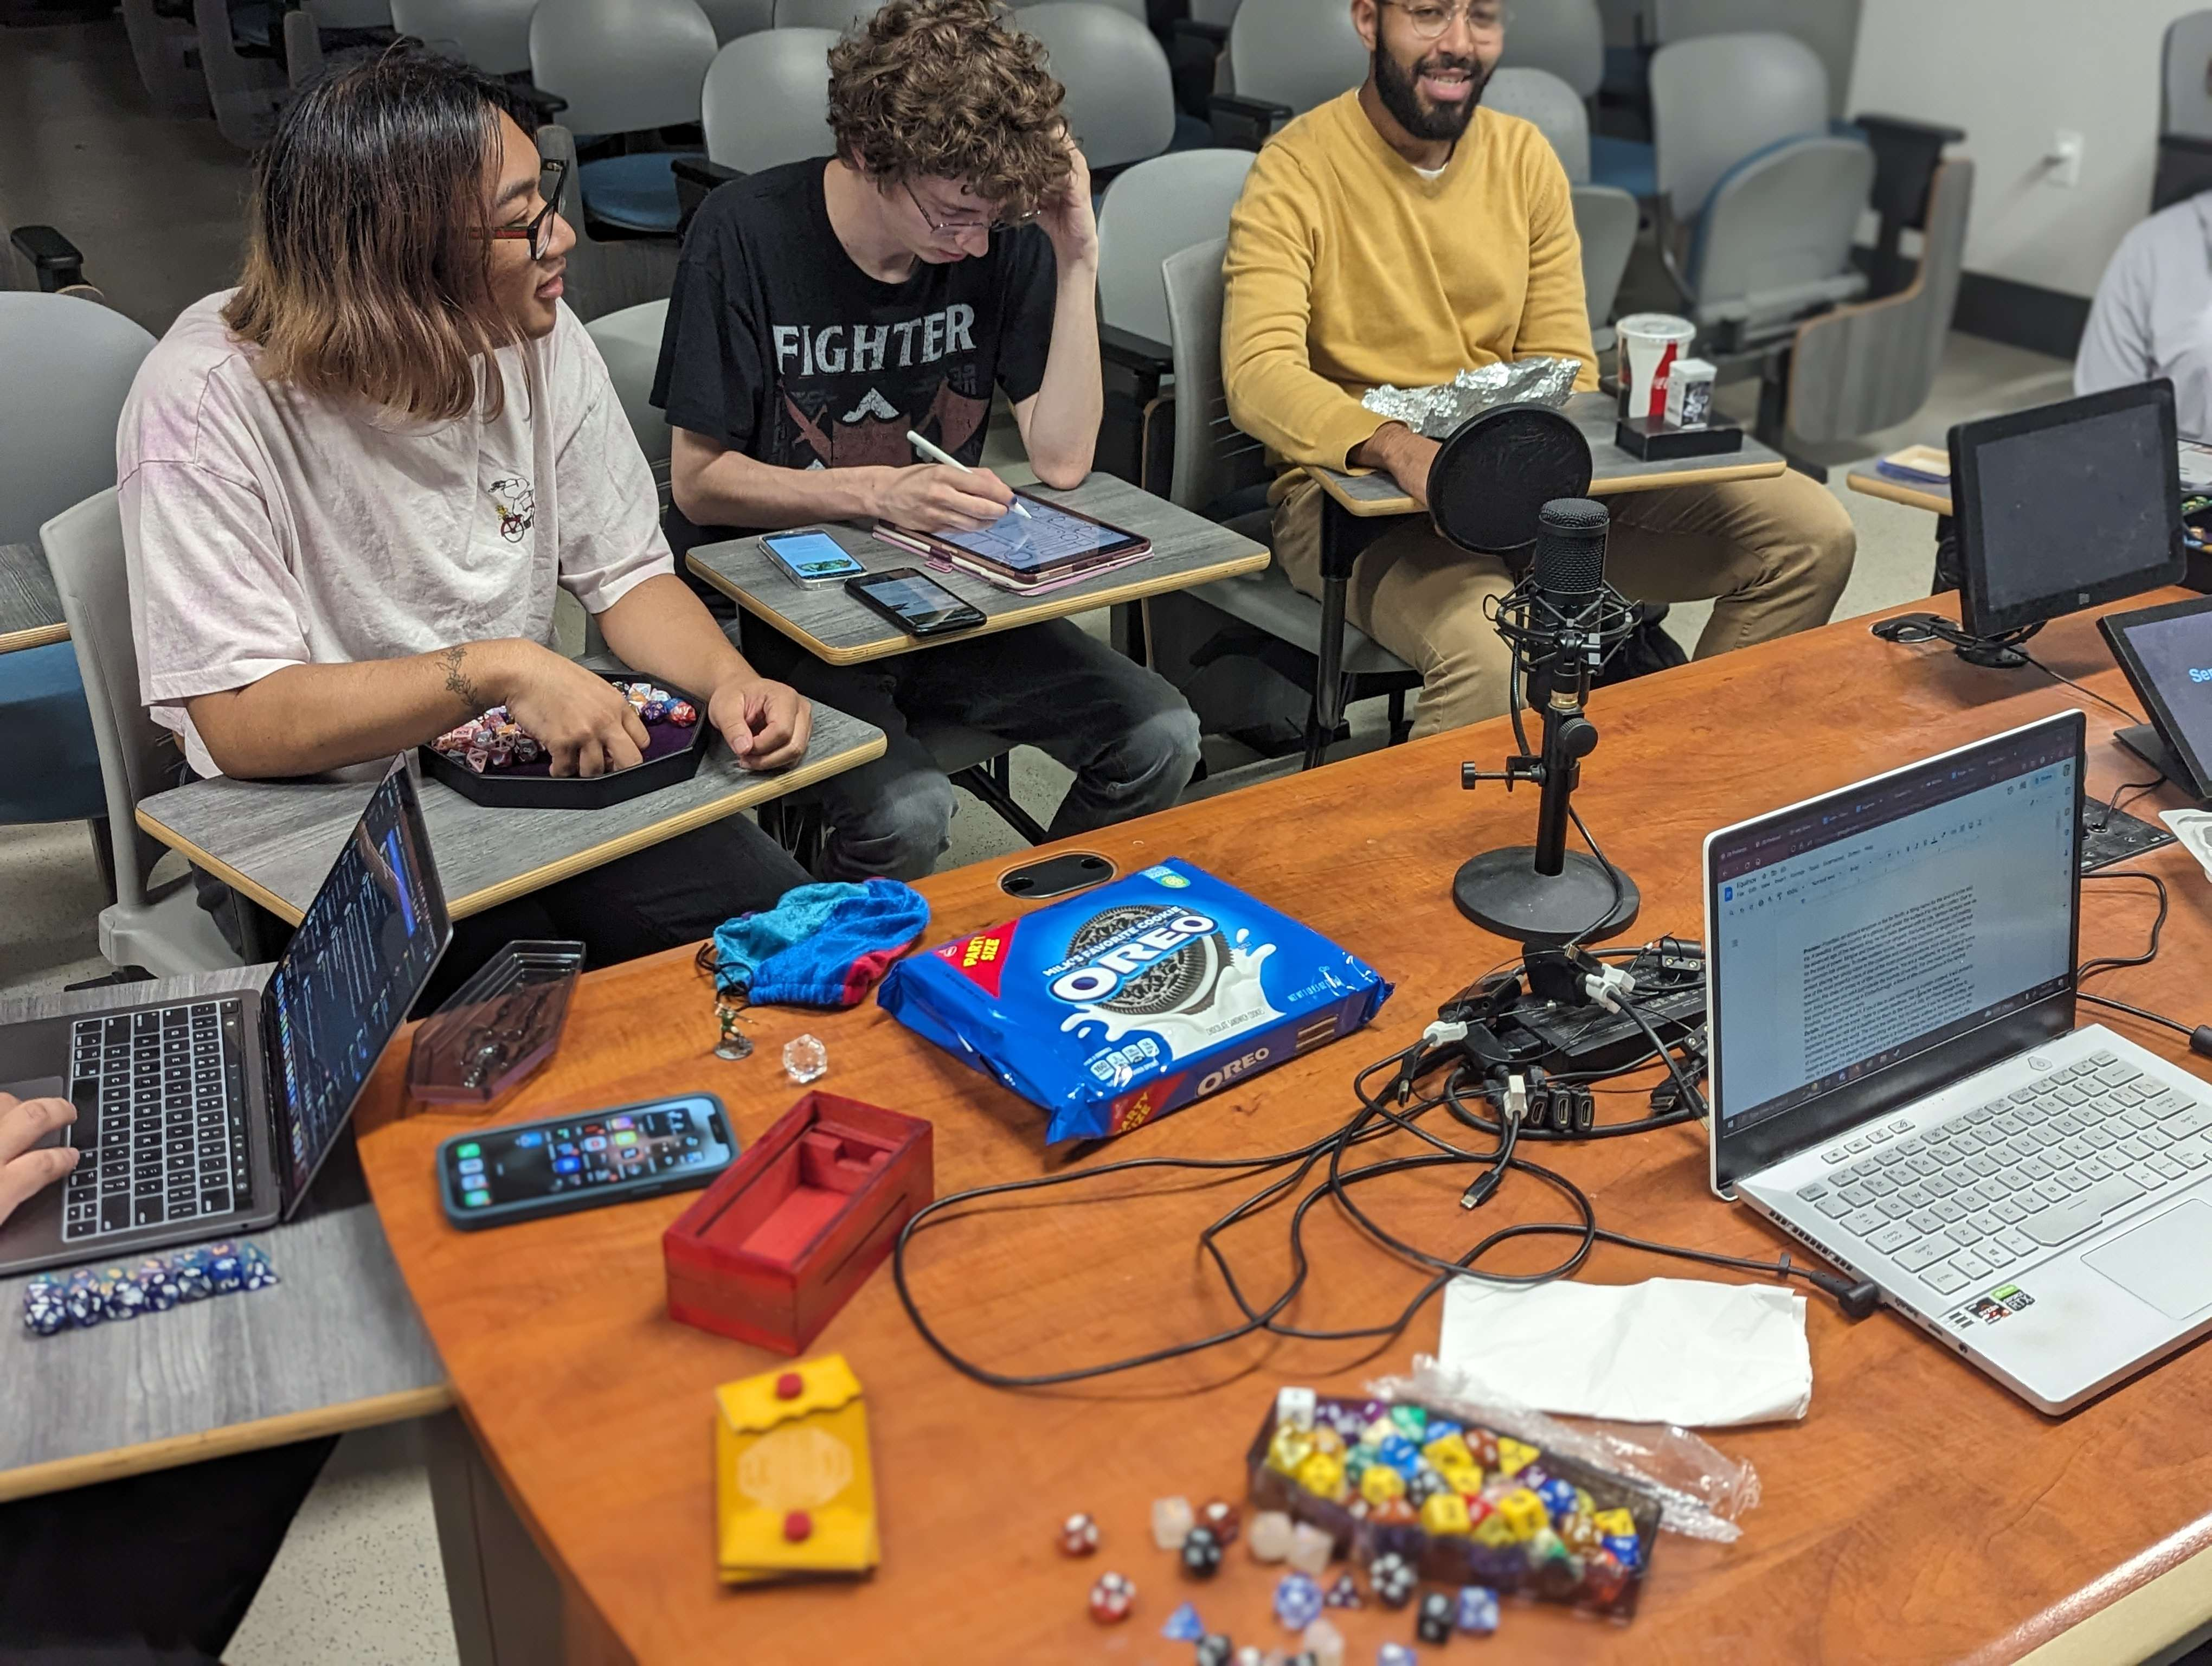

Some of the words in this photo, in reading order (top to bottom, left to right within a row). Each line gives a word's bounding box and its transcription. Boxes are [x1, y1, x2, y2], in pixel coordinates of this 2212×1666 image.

[773, 303, 976, 376] FIGHTER
[980, 939, 1000, 961] SIZE
[1043, 953, 1084, 976] MILK'S
[1083, 926, 1138, 958] FAVORITE
[1138, 906, 1182, 930] COOKIE
[1053, 915, 1214, 1001] OREO
[1198, 1048, 1269, 1096] OREO
